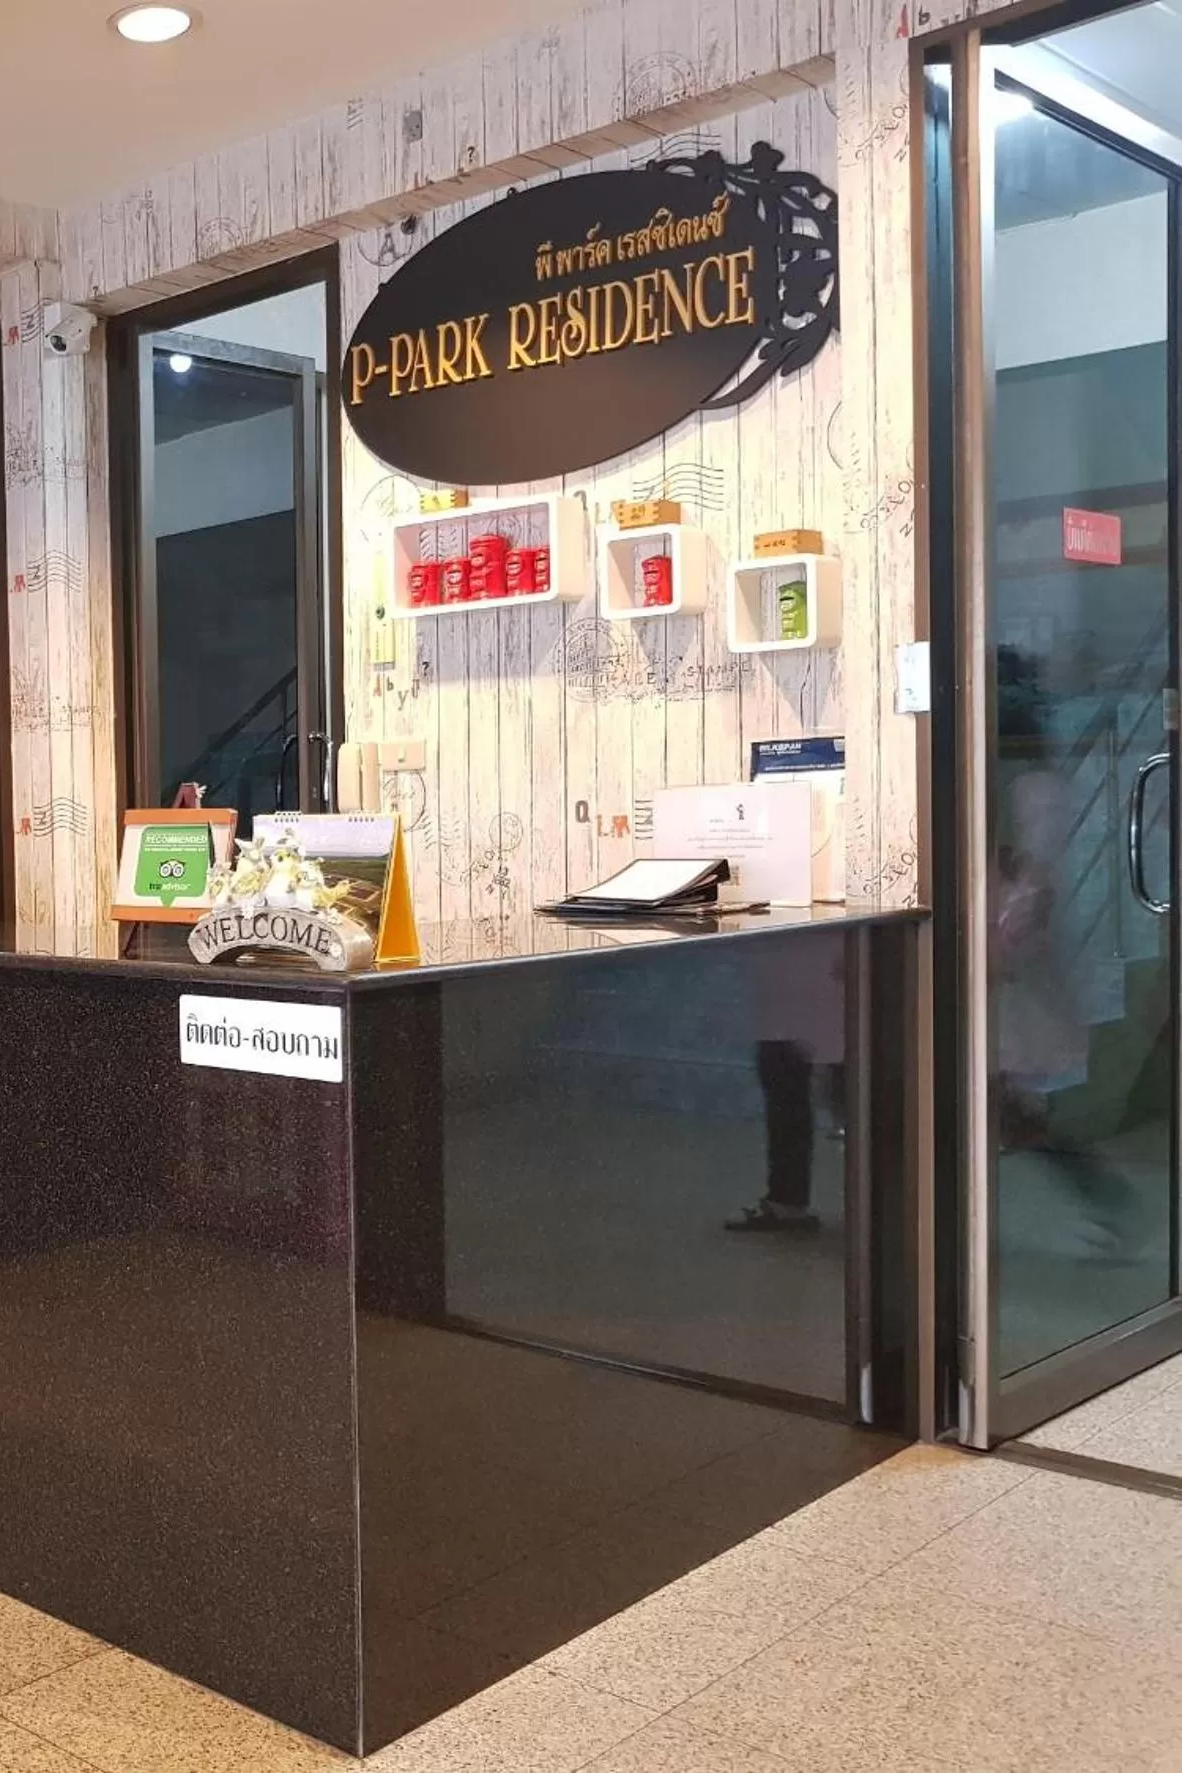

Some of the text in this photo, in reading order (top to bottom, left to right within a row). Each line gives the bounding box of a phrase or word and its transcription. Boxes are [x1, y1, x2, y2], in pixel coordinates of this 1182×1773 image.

[534, 241, 554, 281] พี
[556, 222, 613, 276] พาร์ค
[350, 248, 756, 404] P-PARK RESIDENCE
[195, 912, 332, 955] WELCOME
